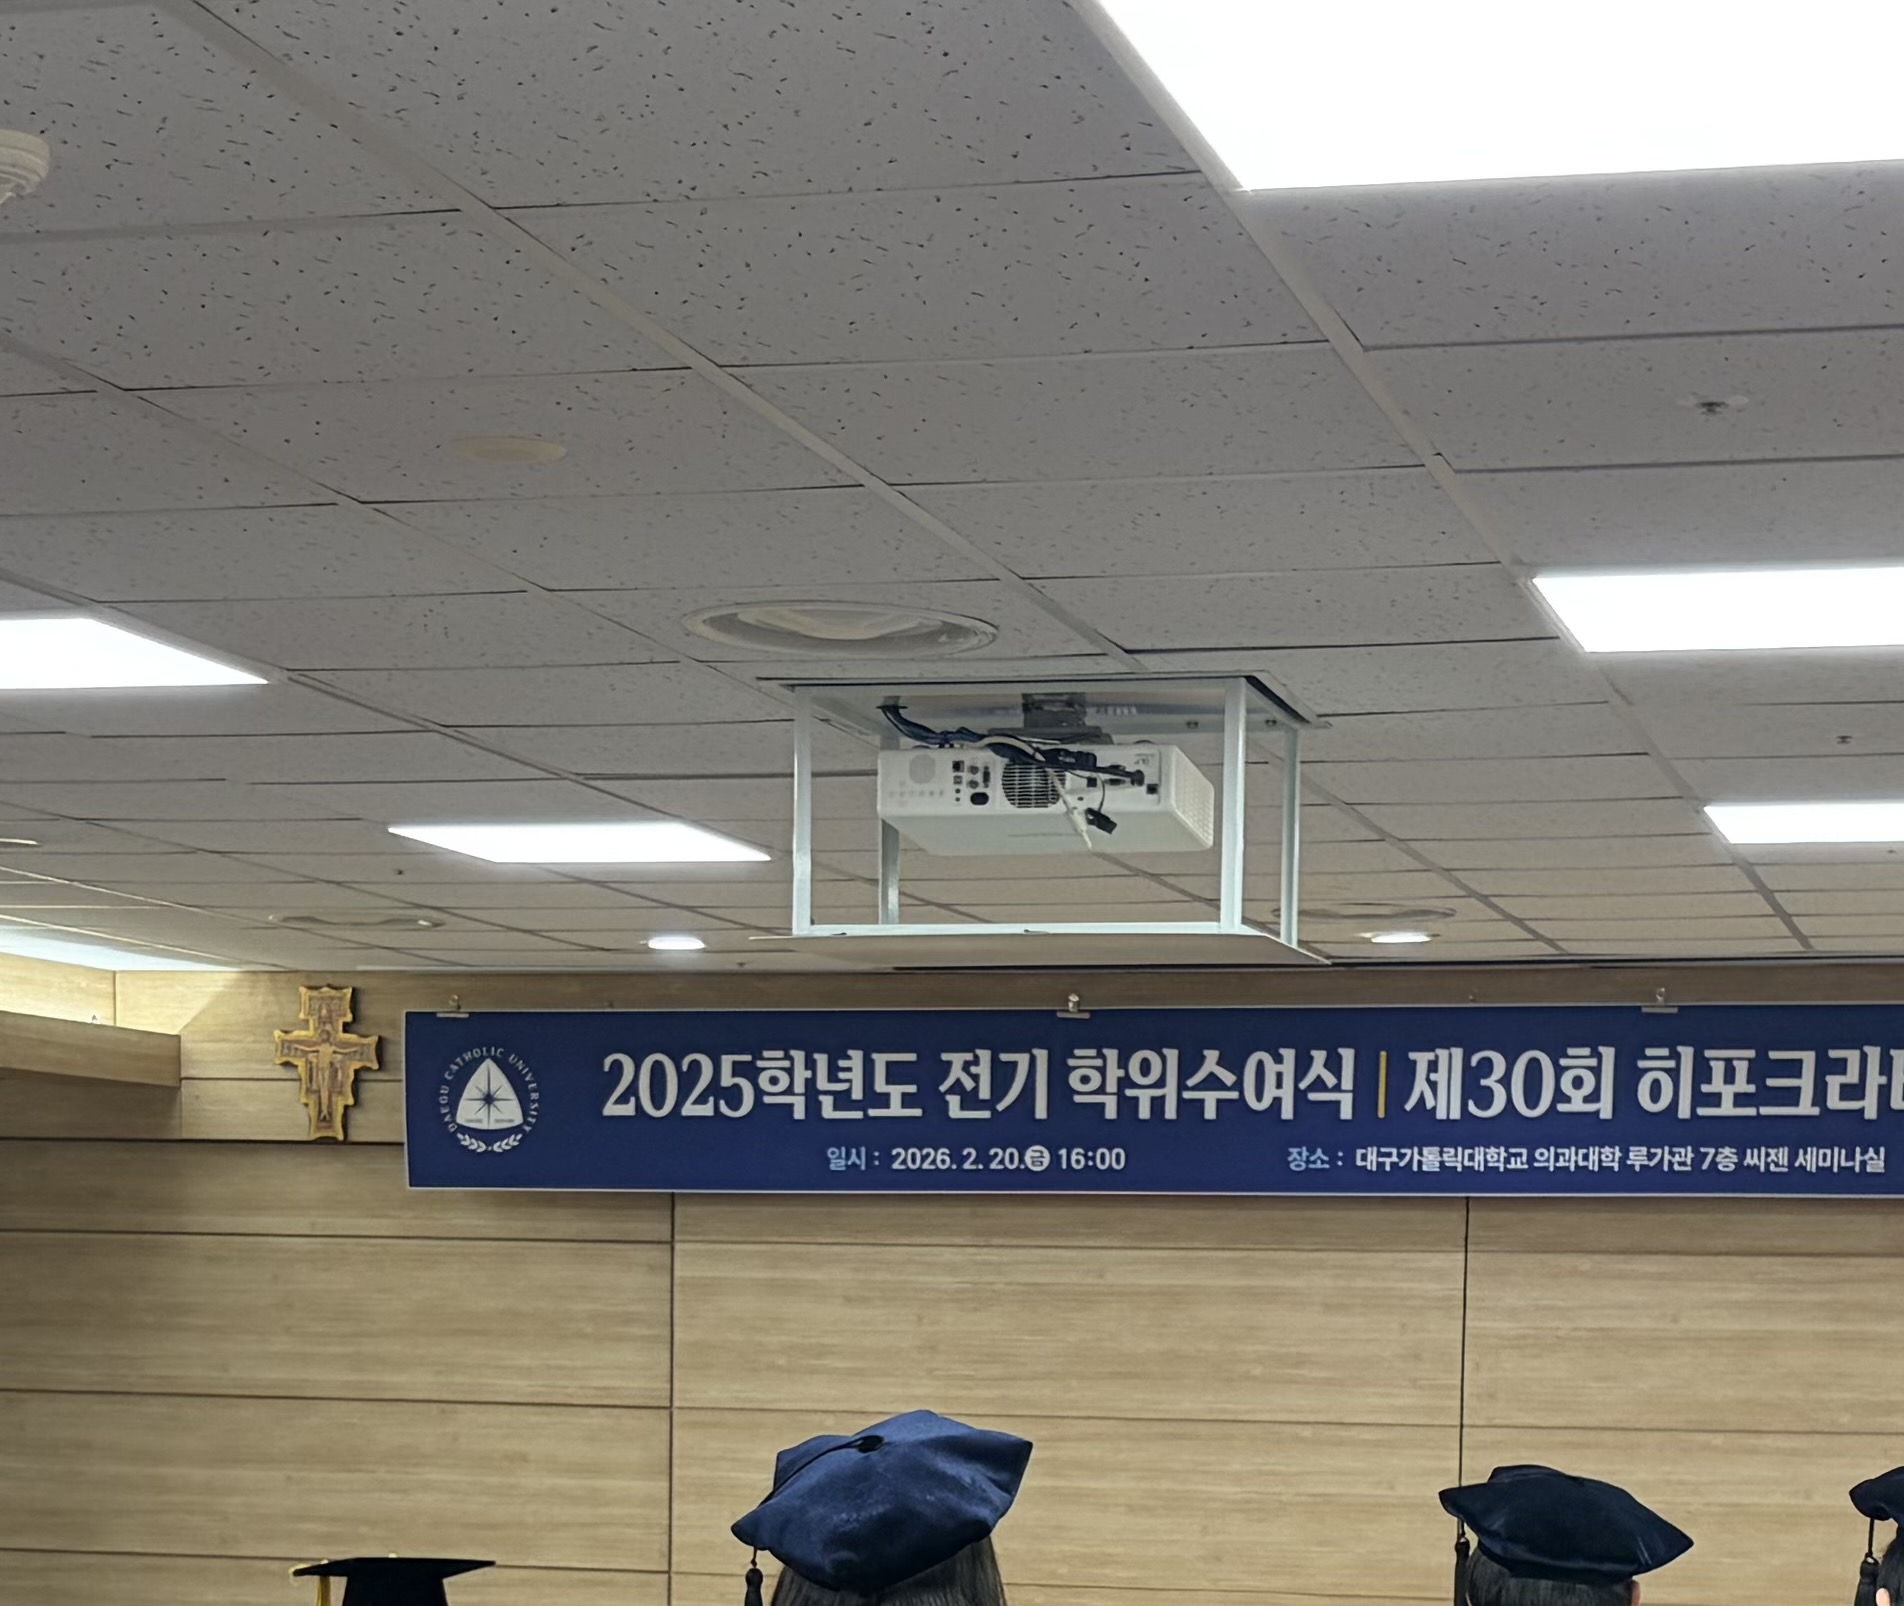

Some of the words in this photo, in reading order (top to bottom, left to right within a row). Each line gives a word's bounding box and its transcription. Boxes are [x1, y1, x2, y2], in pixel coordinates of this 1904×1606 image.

[444, 1046, 505, 1080] CATHOLIC
[601, 1049, 924, 1120] 2025학년도
[938, 1048, 1049, 1120] 전기
[1066, 1048, 1355, 1120] 학위수여식
[1403, 1046, 1616, 1120] 제30회
[439, 1085, 458, 1133] DAEGU
[508, 1053, 540, 1134] UNIVERSITY
[891, 1148, 957, 1170] 2026.
[1058, 1148, 1126, 1170] 16:00
[1355, 1146, 1529, 1172] 대구가톨릭대학교
[1533, 1146, 1622, 1172] 의과대학
[1626, 1146, 1694, 1172] 루가관
[1700, 1147, 1738, 1172] 7층
[1744, 1147, 1789, 1173] 씨젠
[1794, 1146, 1886, 1173] 세미나실
